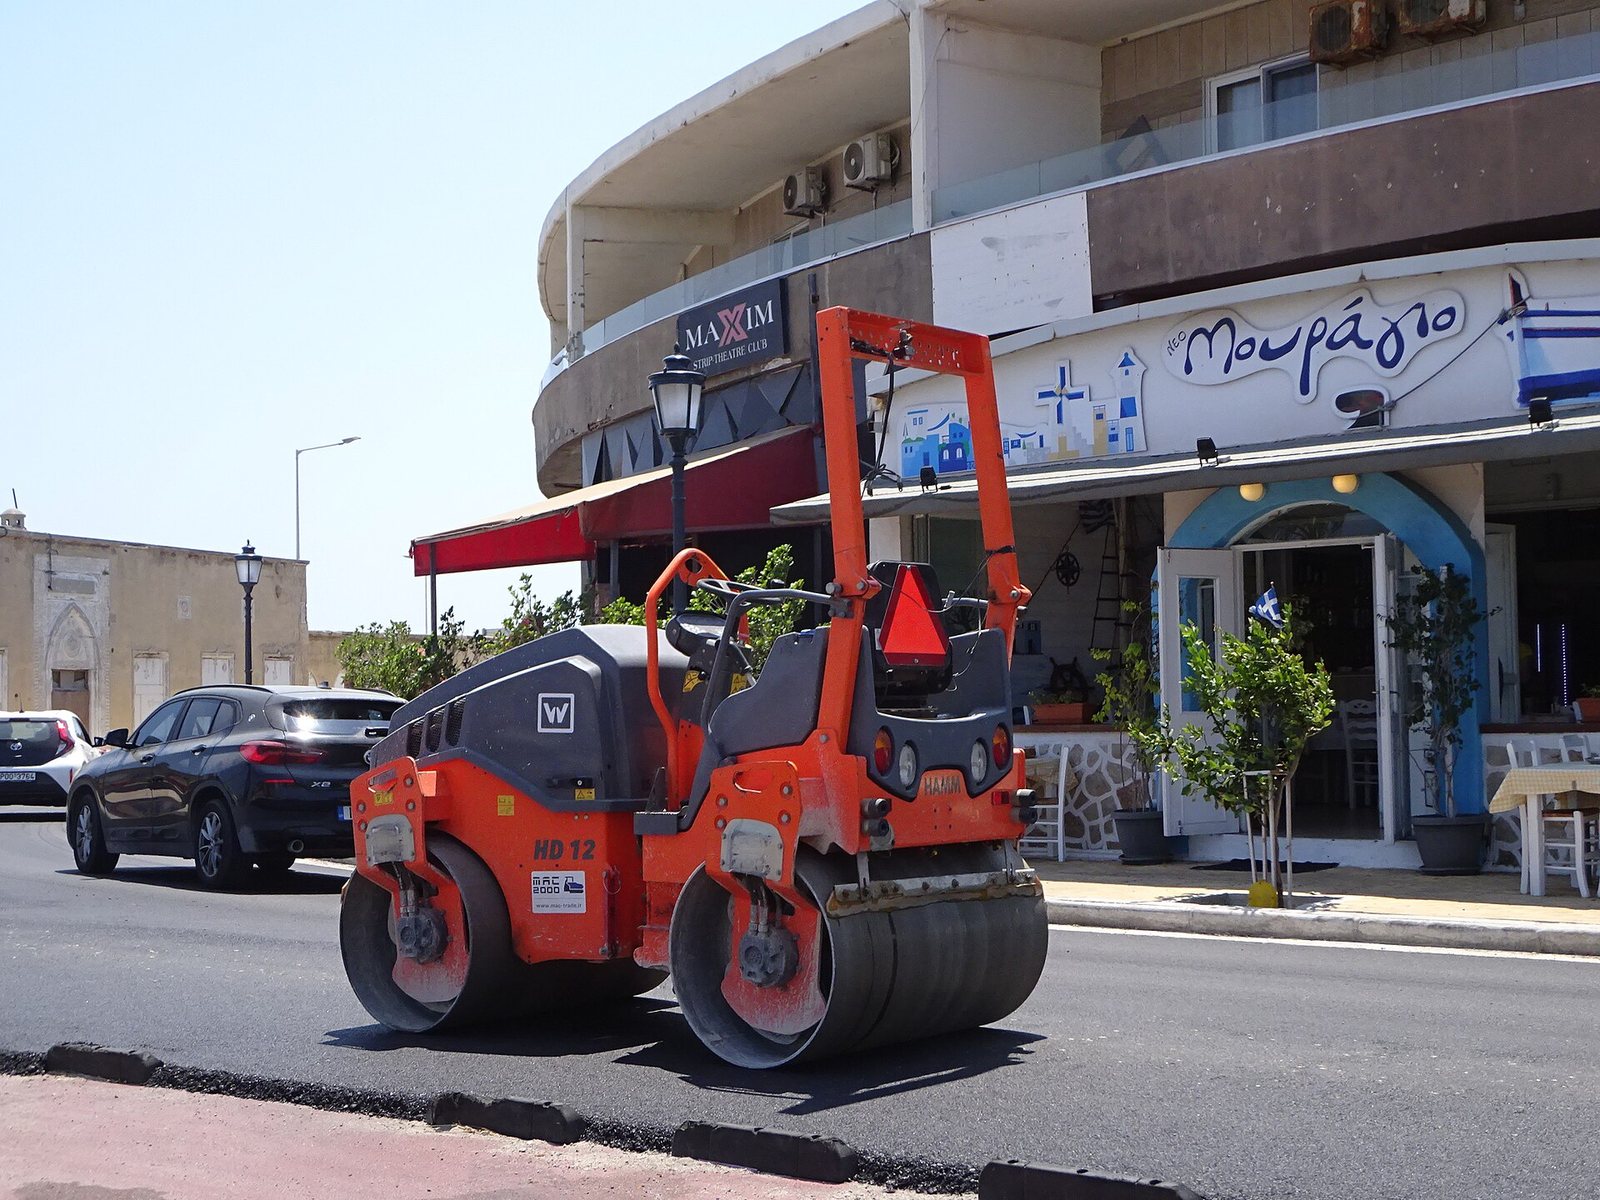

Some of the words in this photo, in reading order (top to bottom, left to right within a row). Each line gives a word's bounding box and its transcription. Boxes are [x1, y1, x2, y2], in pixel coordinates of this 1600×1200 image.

[685, 300, 774, 351] MAXIM
[747, 338, 768, 354] CLUB
[543, 703, 569, 724] W
[924, 776, 960, 795] HAMM
[533, 840, 564, 860] HD
[570, 840, 596, 860] 12
[533, 886, 560, 894] 2000
